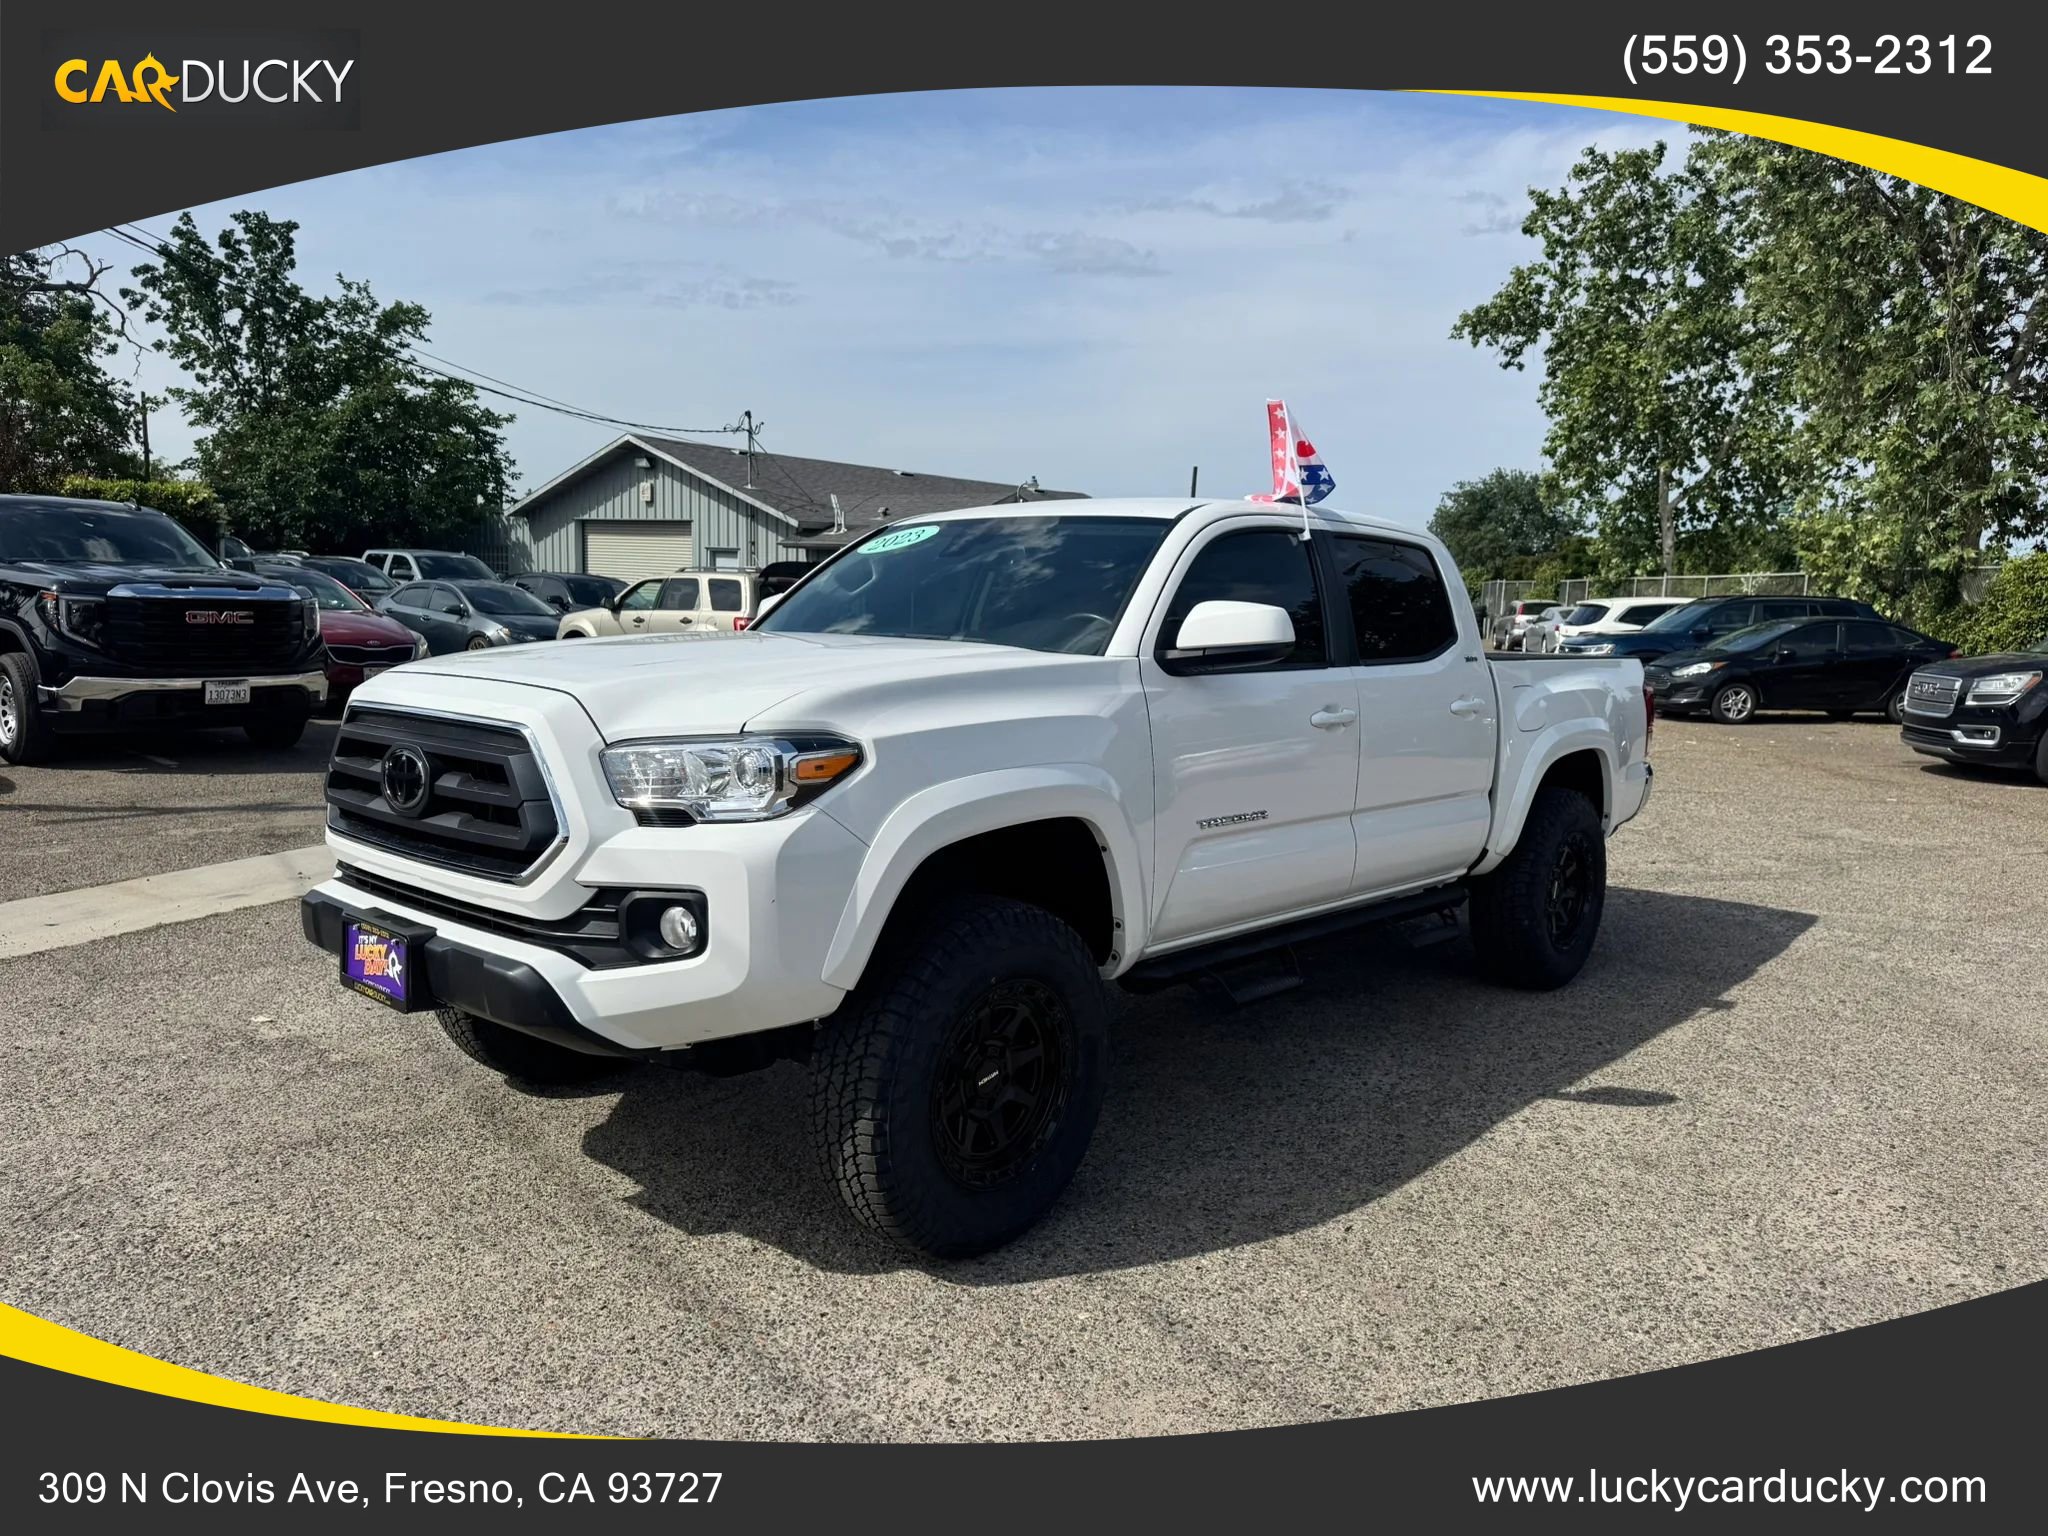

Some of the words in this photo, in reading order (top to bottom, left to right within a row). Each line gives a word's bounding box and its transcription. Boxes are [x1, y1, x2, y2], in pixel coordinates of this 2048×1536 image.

[867, 529, 925, 551] 2023
[185, 611, 254, 624] GMC
[355, 944, 387, 960] LUCKY
